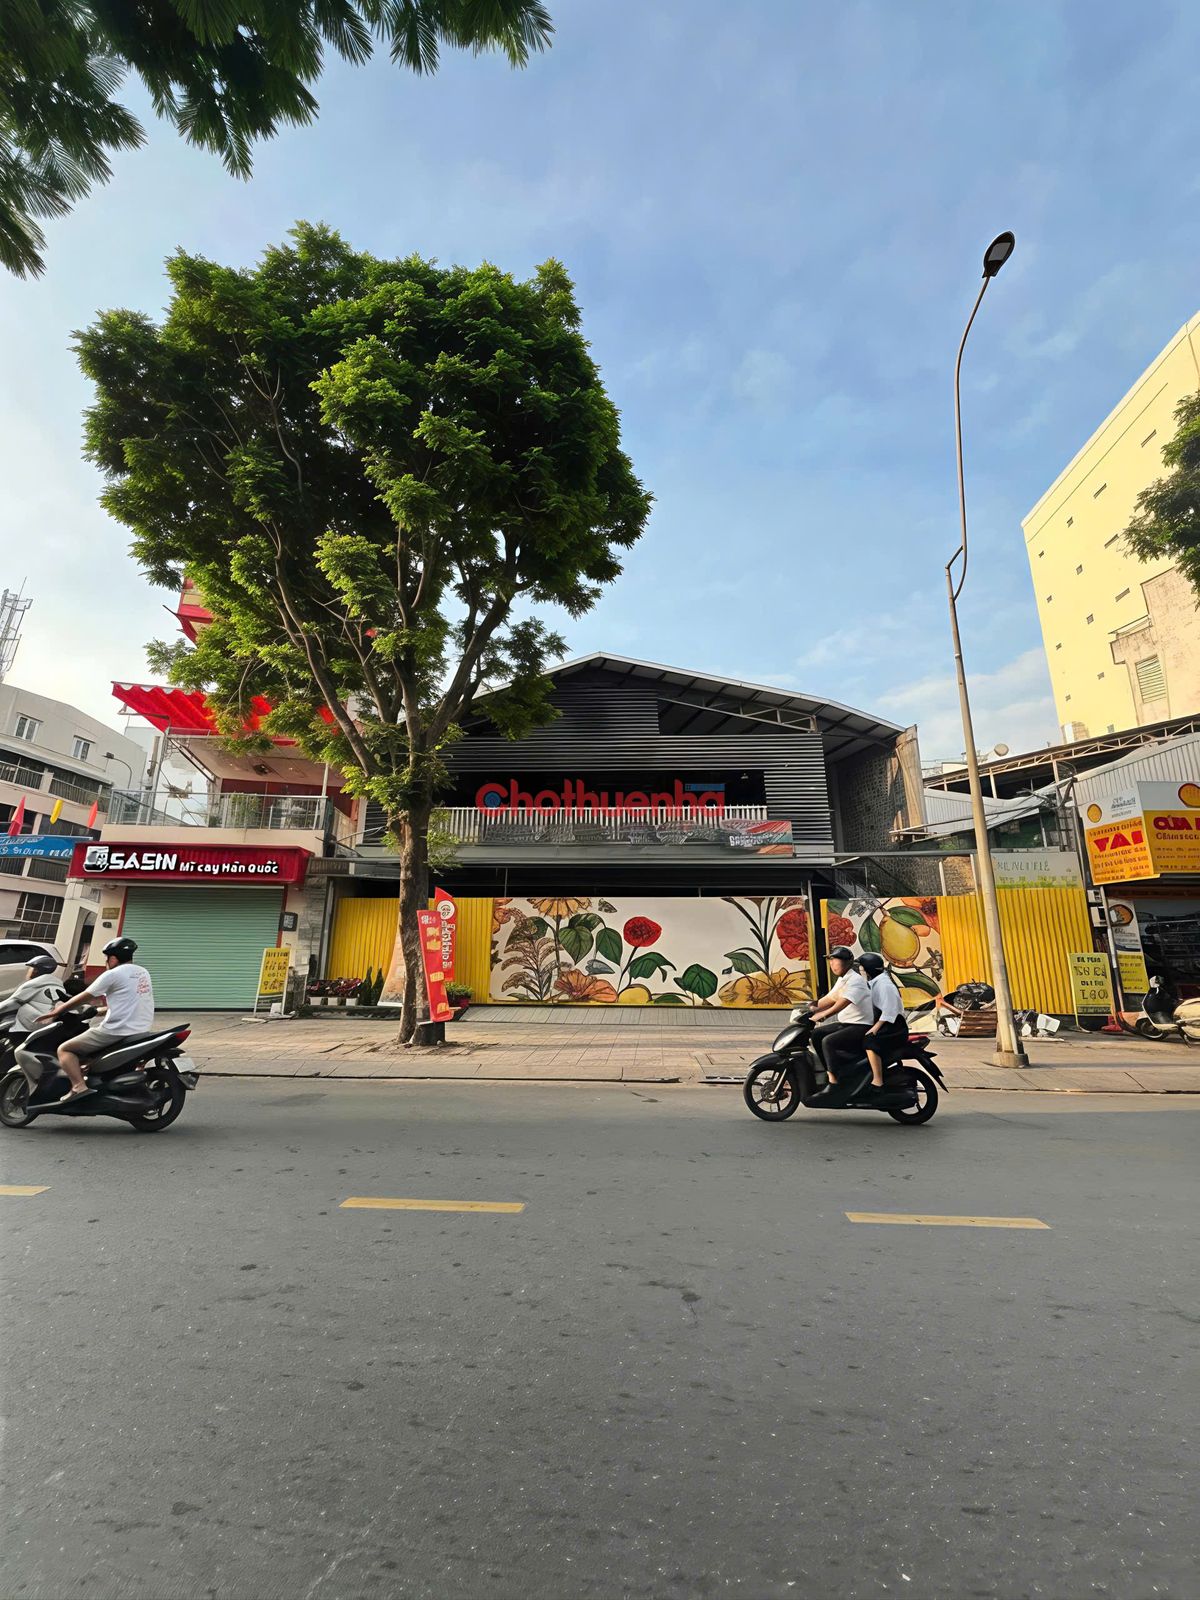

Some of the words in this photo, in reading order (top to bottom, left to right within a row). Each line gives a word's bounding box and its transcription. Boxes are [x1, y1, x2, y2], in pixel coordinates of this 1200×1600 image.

[109, 852, 177, 870] SASIN
[198, 864, 219, 874] cay
[248, 860, 278, 873] Quốc
